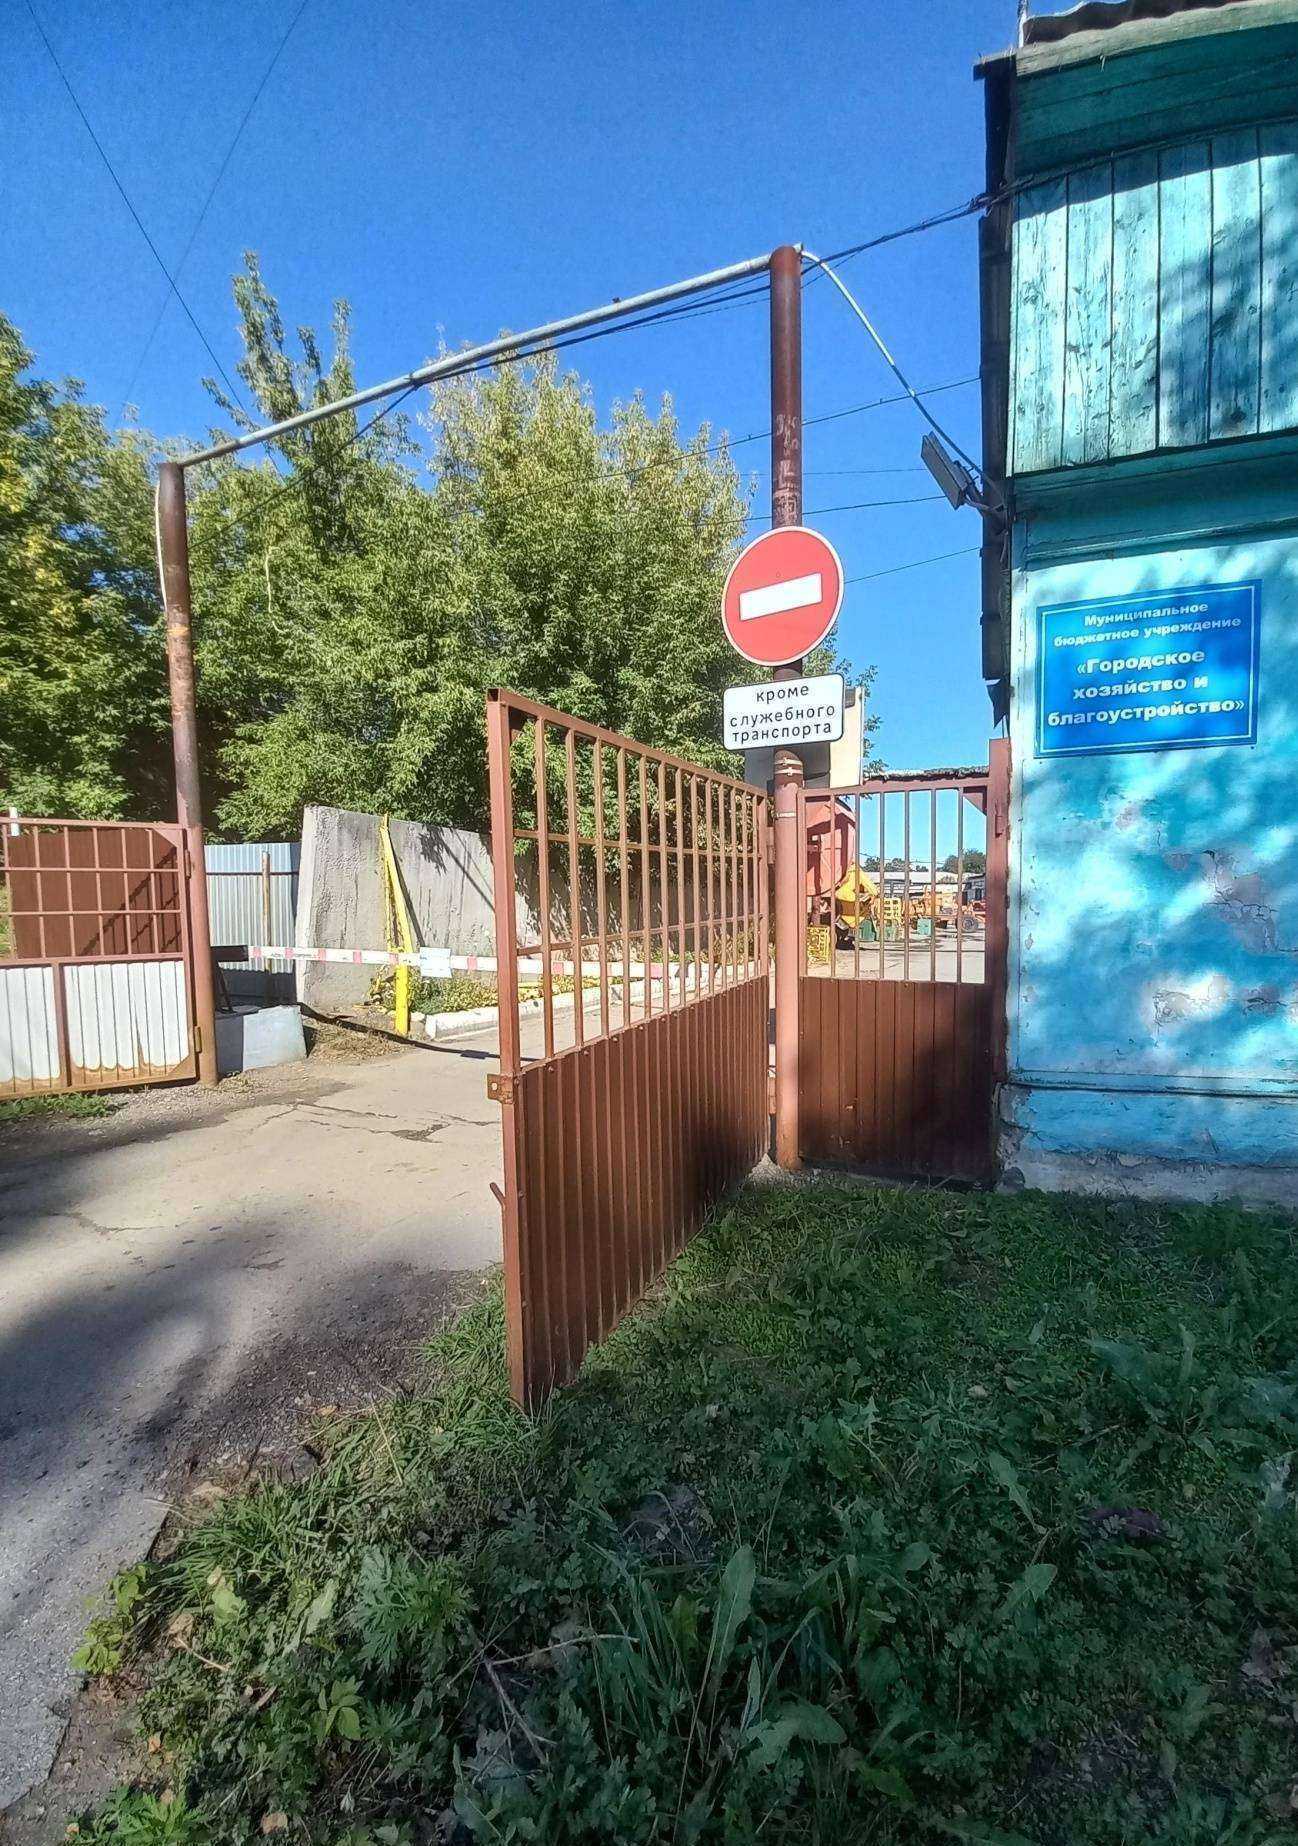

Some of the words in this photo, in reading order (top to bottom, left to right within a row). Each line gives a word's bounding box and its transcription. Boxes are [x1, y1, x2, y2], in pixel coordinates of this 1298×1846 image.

[1084, 602, 1209, 626] Муниципальное
[1054, 628, 1139, 647] бюджетное
[1143, 617, 1242, 639] учреждение
[1076, 651, 1205, 675] «Городское
[756, 685, 809, 704] кроме
[1073, 677, 1187, 699] хозяйство
[1193, 676, 1209, 689] и
[729, 705, 835, 727] служебного
[1047, 699, 1245, 726] благоустройство»
[732, 722, 832, 744] транспорта
